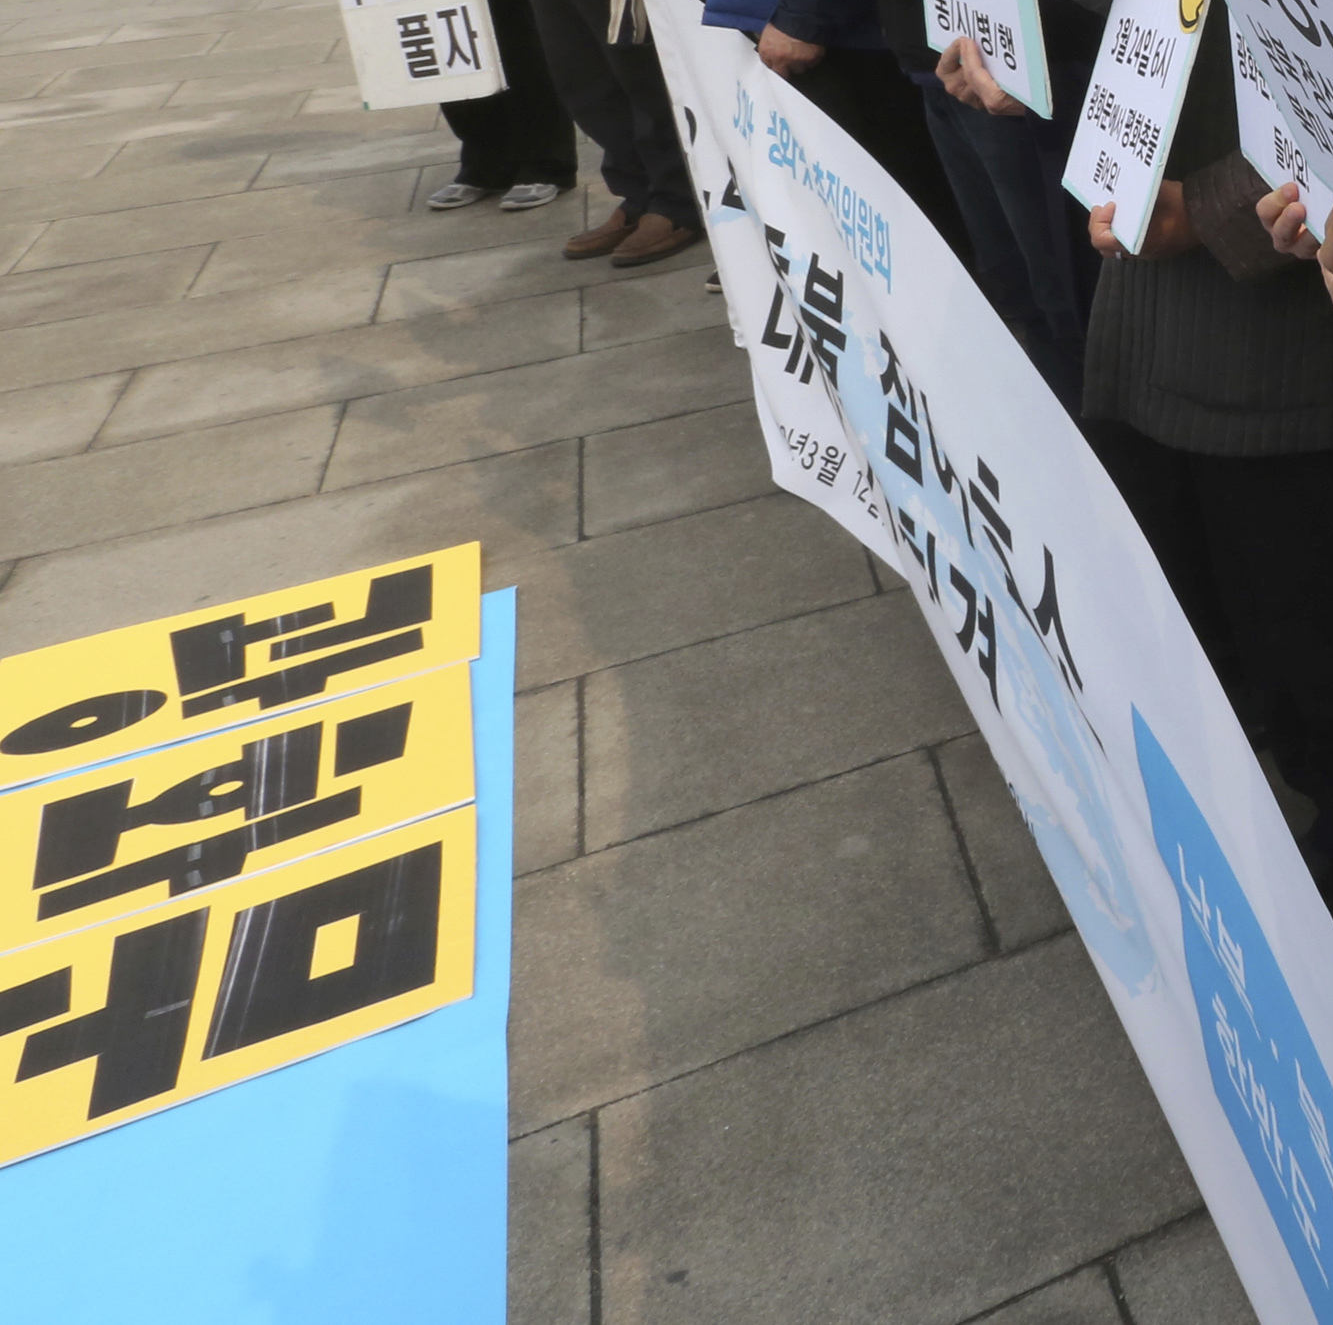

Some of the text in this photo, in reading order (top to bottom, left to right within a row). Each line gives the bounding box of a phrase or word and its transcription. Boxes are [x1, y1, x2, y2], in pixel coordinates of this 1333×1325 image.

[397, 5, 482, 79] 풀자
[1110, 17, 1177, 90] 3월 24일 6시
[1246, 14, 1311, 101] 남북
[1086, 83, 1162, 168] 광화문에서 평화촛불
[1273, 125, 1311, 194] 들어요!
